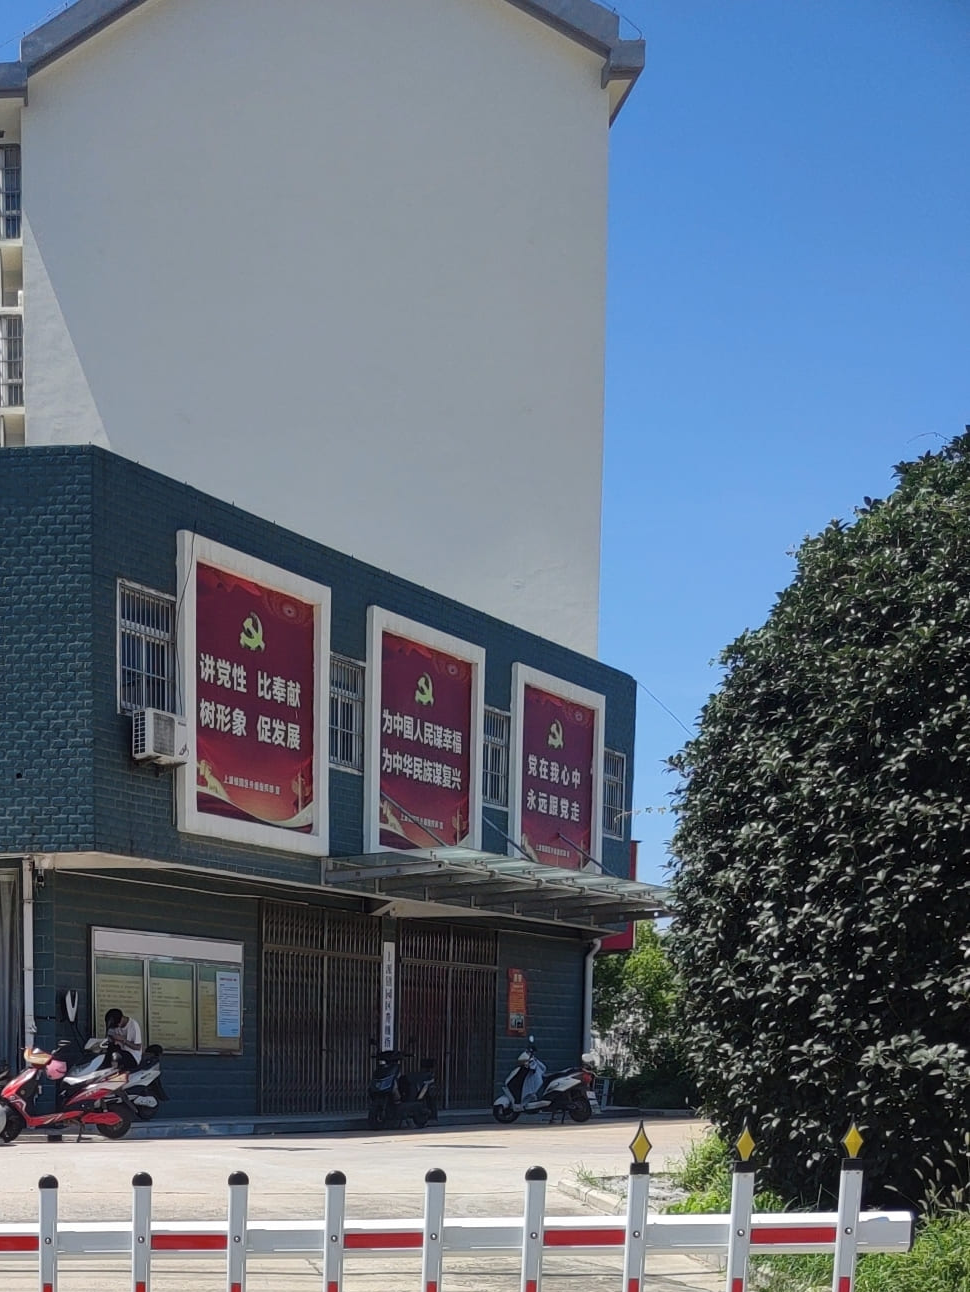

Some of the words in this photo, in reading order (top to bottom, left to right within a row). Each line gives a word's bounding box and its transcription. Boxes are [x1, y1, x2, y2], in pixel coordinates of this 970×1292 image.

[199, 653, 247, 693] 讲党性
[257, 670, 301, 708] 比奉献
[199, 698, 247, 737] 树形象
[256, 715, 301, 750] 促发展
[382, 709, 463, 755] 为中国人民谋幸福
[382, 748, 462, 790] 为中华民族谋复兴
[527, 754, 581, 789] 党在我心中
[526, 788, 581, 823] 永远跟党走
